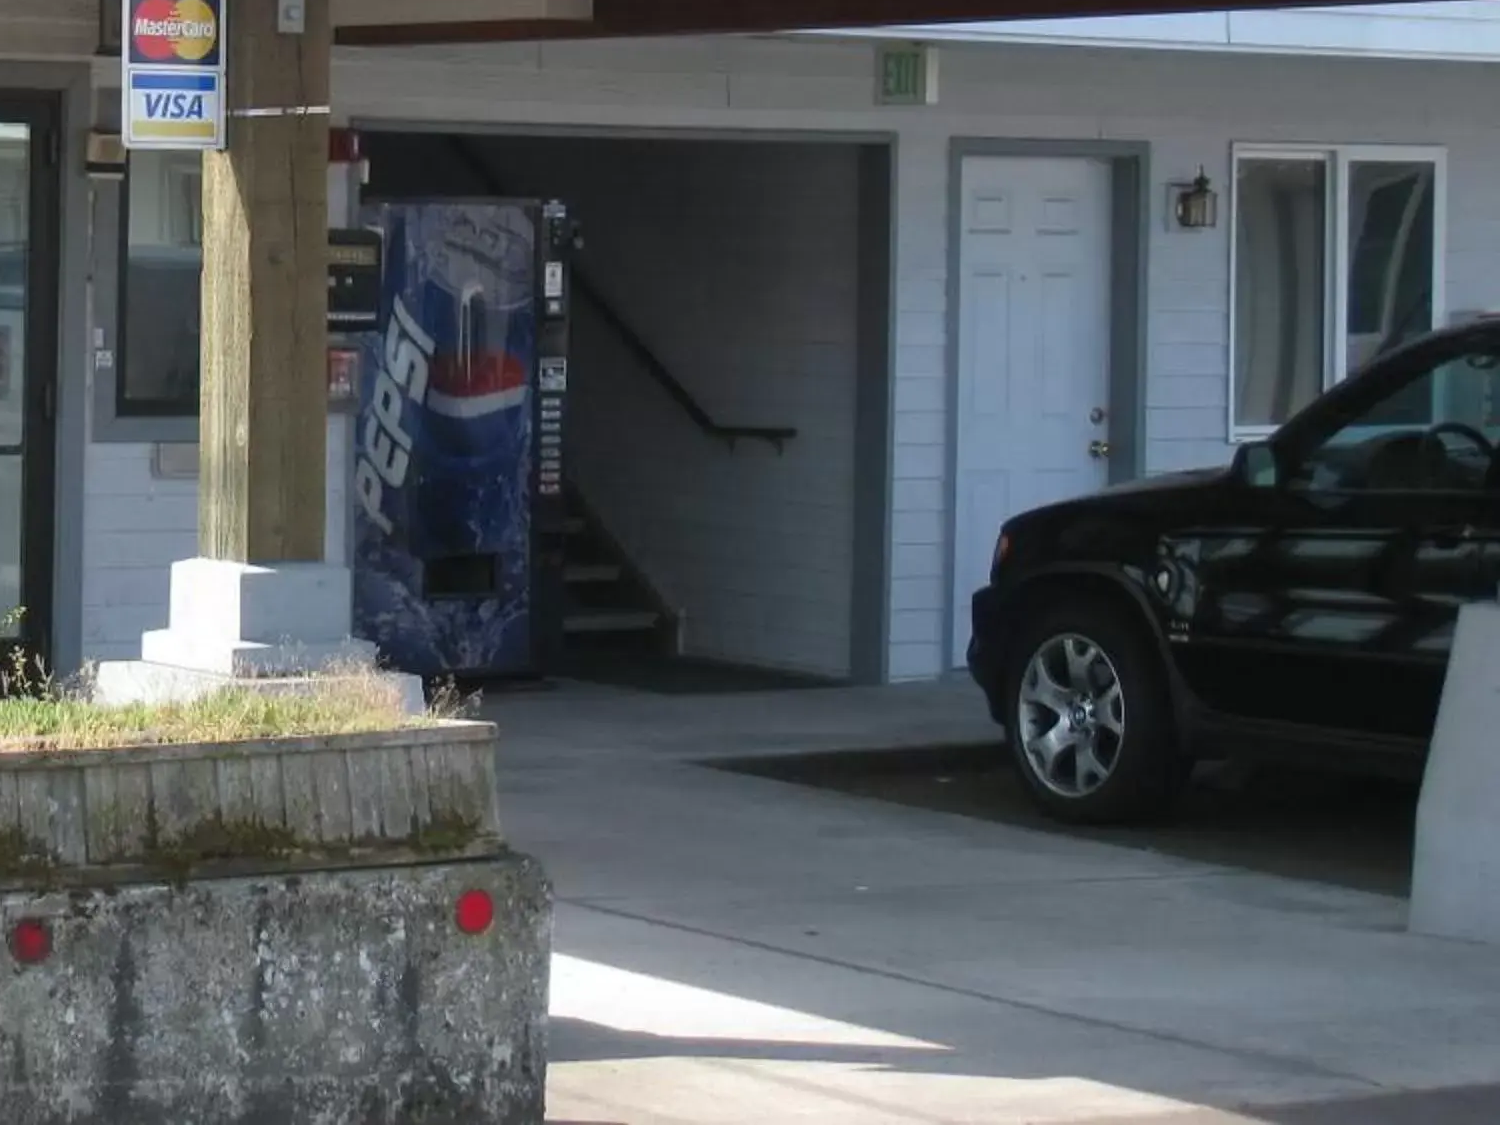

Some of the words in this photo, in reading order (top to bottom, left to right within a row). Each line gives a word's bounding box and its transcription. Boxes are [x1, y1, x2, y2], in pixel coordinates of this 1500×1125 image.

[134, 17, 213, 36] MasterCard
[145, 93, 203, 119] VISA
[356, 293, 436, 536] PEPSI
